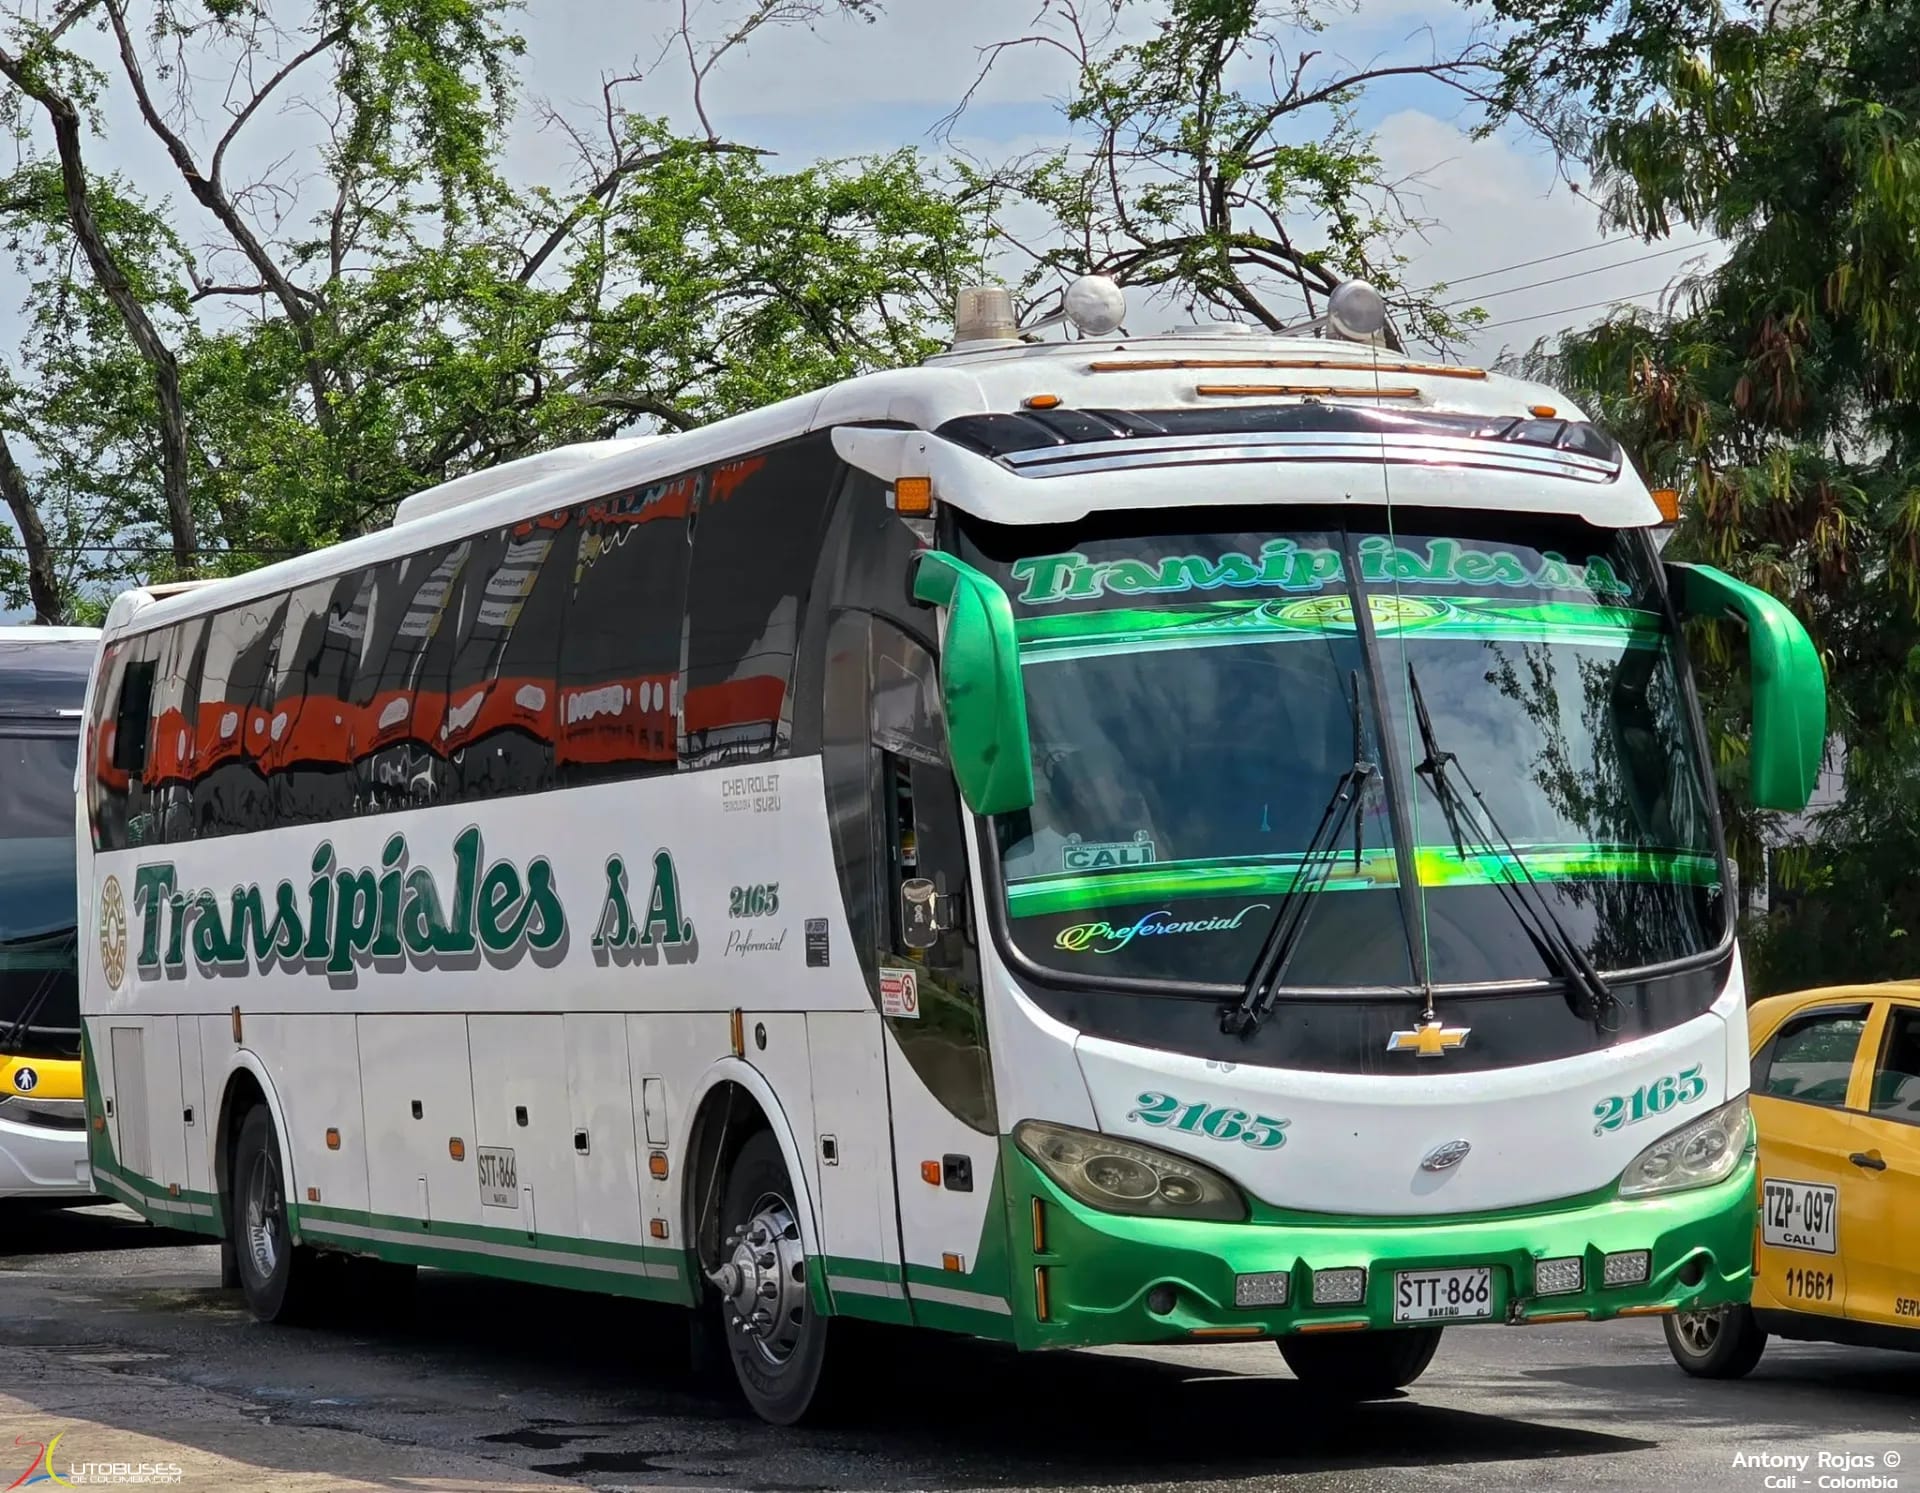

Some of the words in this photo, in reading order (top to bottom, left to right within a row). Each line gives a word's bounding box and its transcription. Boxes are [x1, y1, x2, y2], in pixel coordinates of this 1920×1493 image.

[1012, 537, 1533, 604] Transipiales
[722, 774, 780, 797] CHEVROLET
[753, 796, 781, 813] ISUZU
[1067, 848, 1151, 867] CALI
[134, 823, 570, 990] Transipiales
[729, 881, 780, 919] 2165
[723, 927, 788, 958] Preferencial
[1053, 903, 1271, 954] Preferencial
[1593, 1062, 1708, 1137] 2165
[1126, 1090, 1292, 1150] 2165
[480, 1154, 517, 1188] STT-866
[1766, 1185, 1834, 1234] TZP-097
[1783, 1233, 1816, 1246] CALI
[1399, 1274, 1489, 1307] STT-866
[1786, 1267, 1834, 1301] 11661
